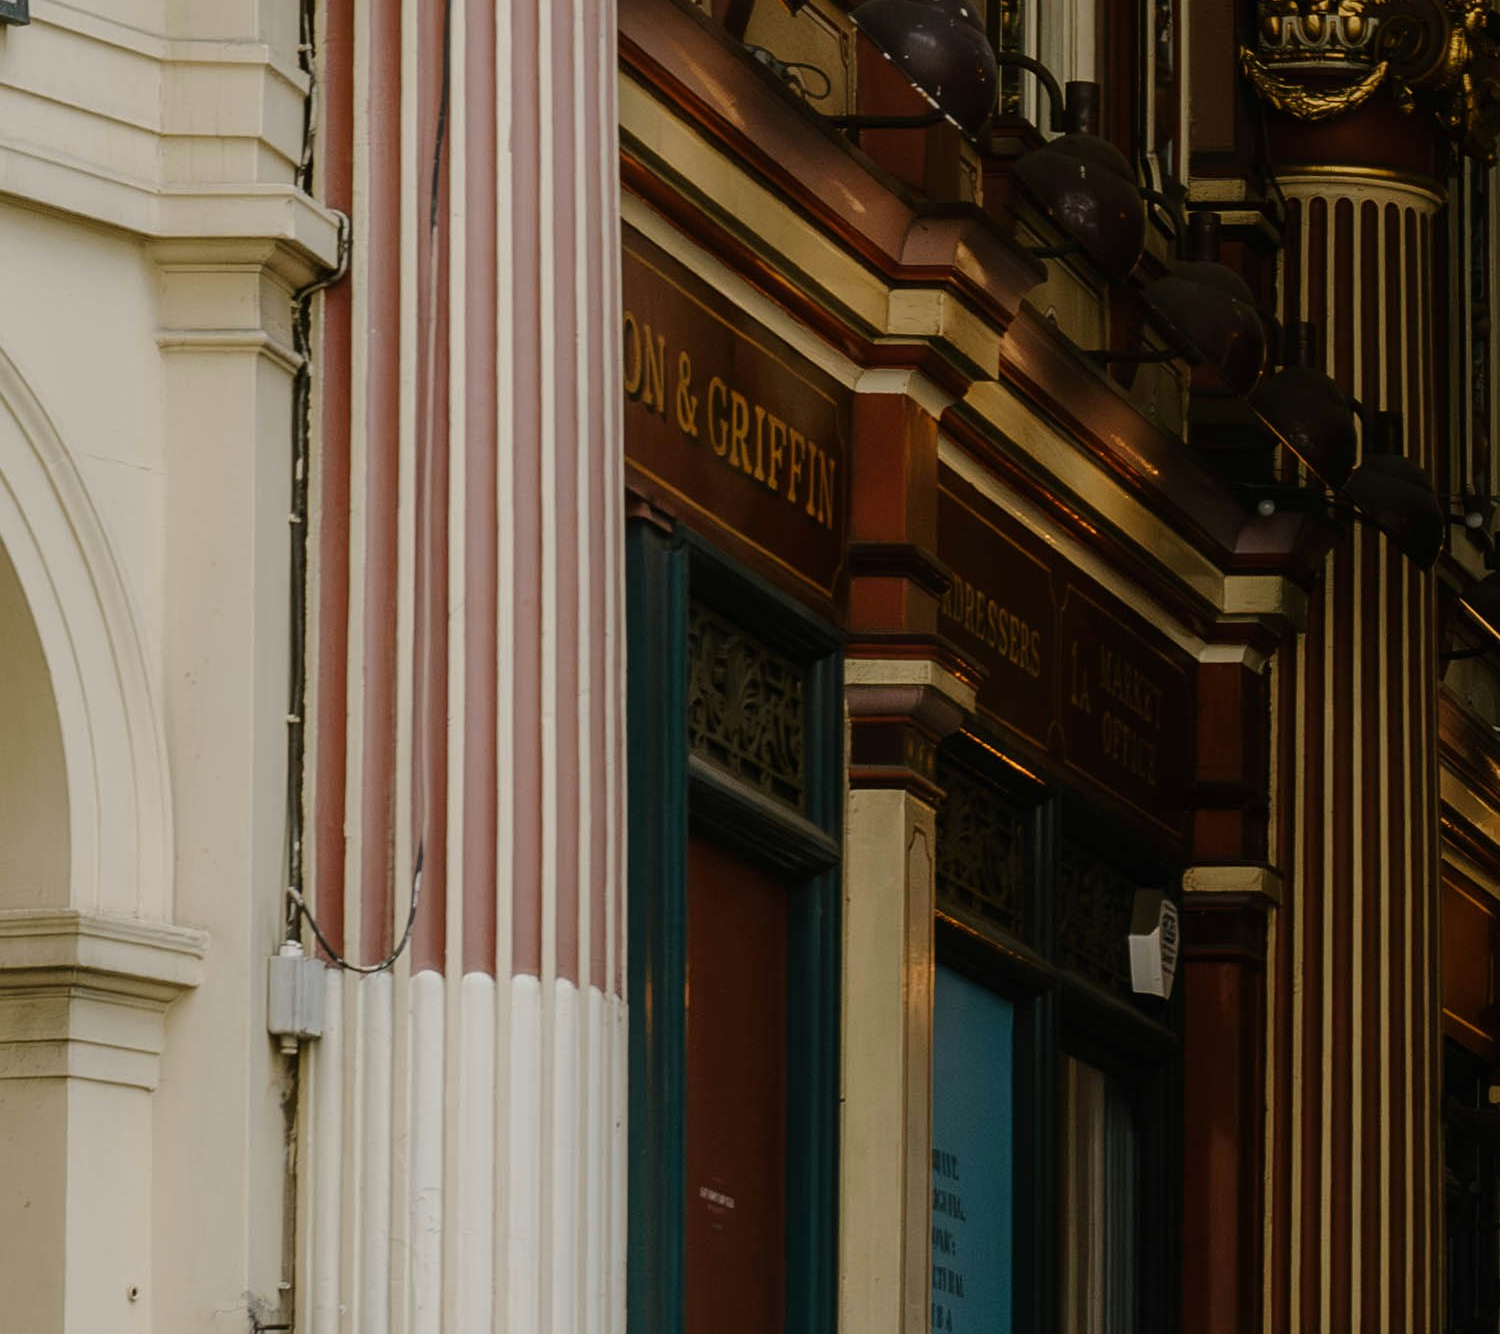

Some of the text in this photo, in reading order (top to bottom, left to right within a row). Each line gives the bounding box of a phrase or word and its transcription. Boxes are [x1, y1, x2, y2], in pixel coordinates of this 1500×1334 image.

[676, 351, 698, 438] &
[708, 376, 837, 531] GRIFFIN
[1099, 643, 1163, 730] MARKET
[1102, 710, 1157, 787] OFFICE
